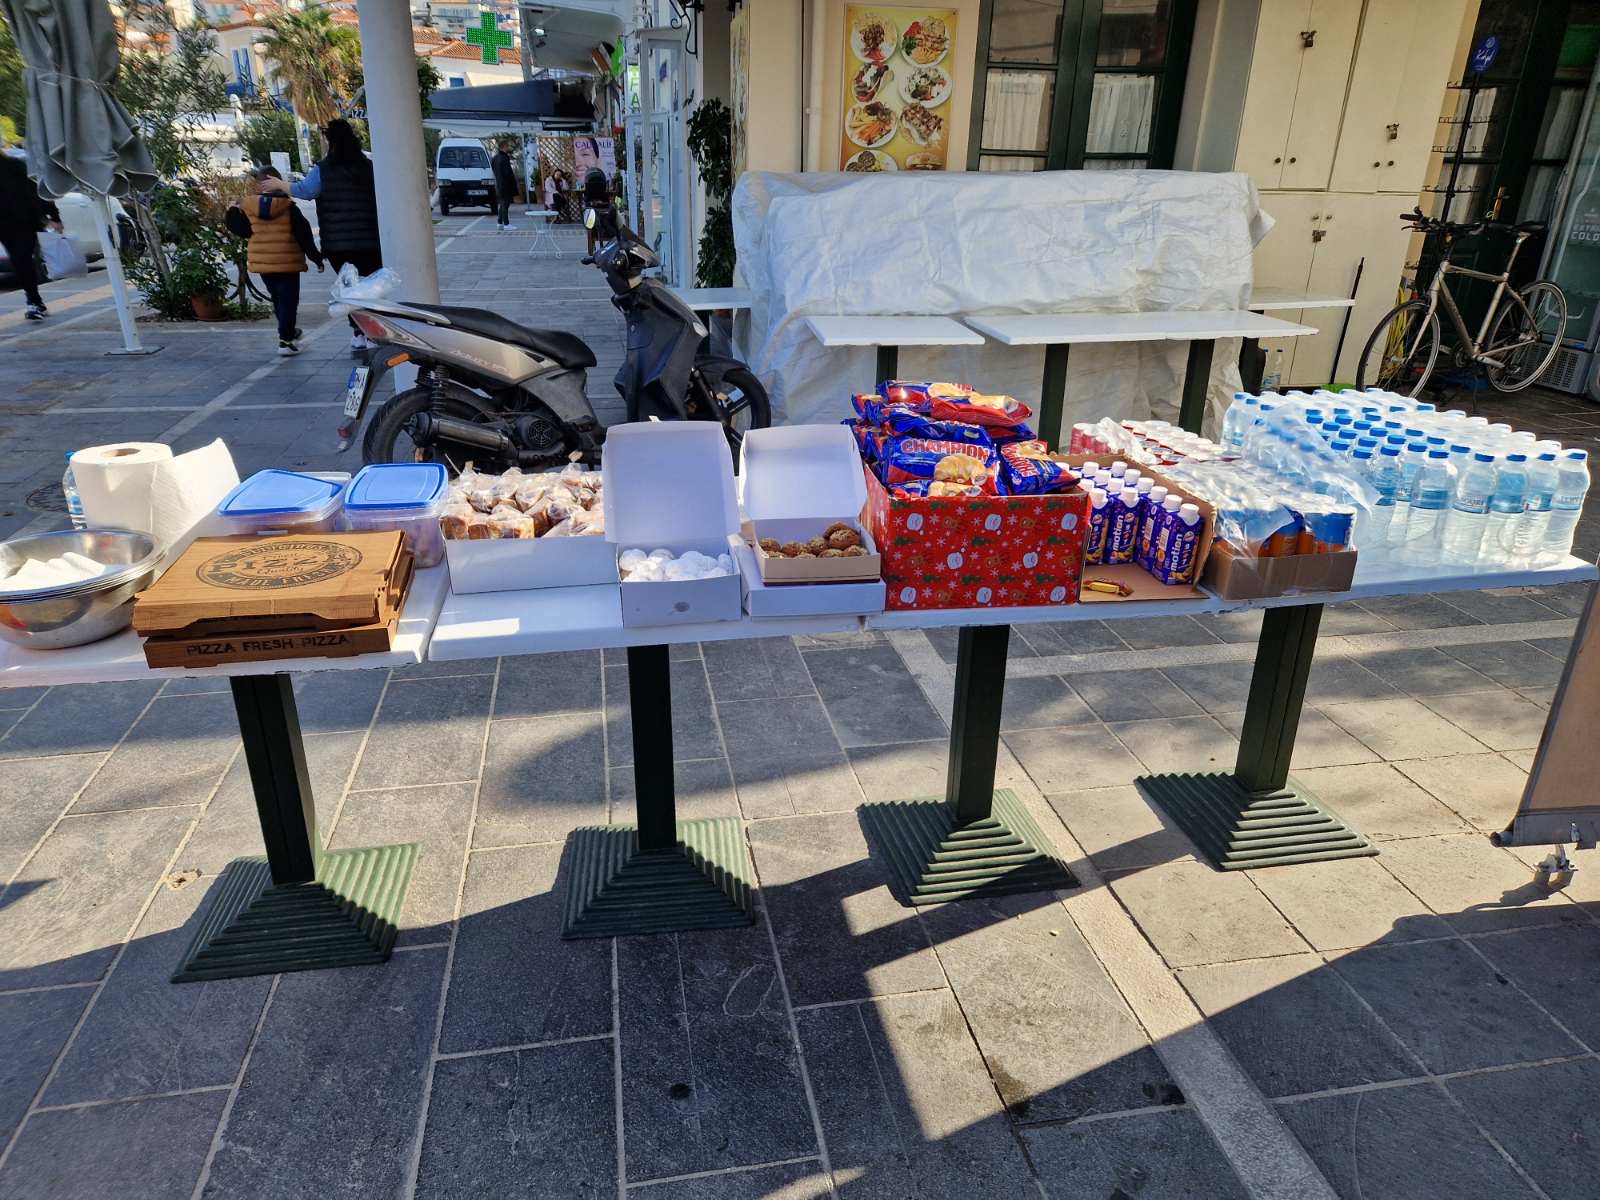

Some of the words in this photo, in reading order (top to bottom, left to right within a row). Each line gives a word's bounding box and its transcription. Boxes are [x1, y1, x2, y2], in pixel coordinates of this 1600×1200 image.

[901, 438, 990, 464] CHAMPION
[1112, 515, 1124, 551] motion
[1171, 533, 1184, 571] motion
[224, 576, 272, 586] MADE
[187, 642, 236, 656] PIZZA
[242, 638, 294, 651] FRESH
[302, 634, 350, 648] PIZZA
